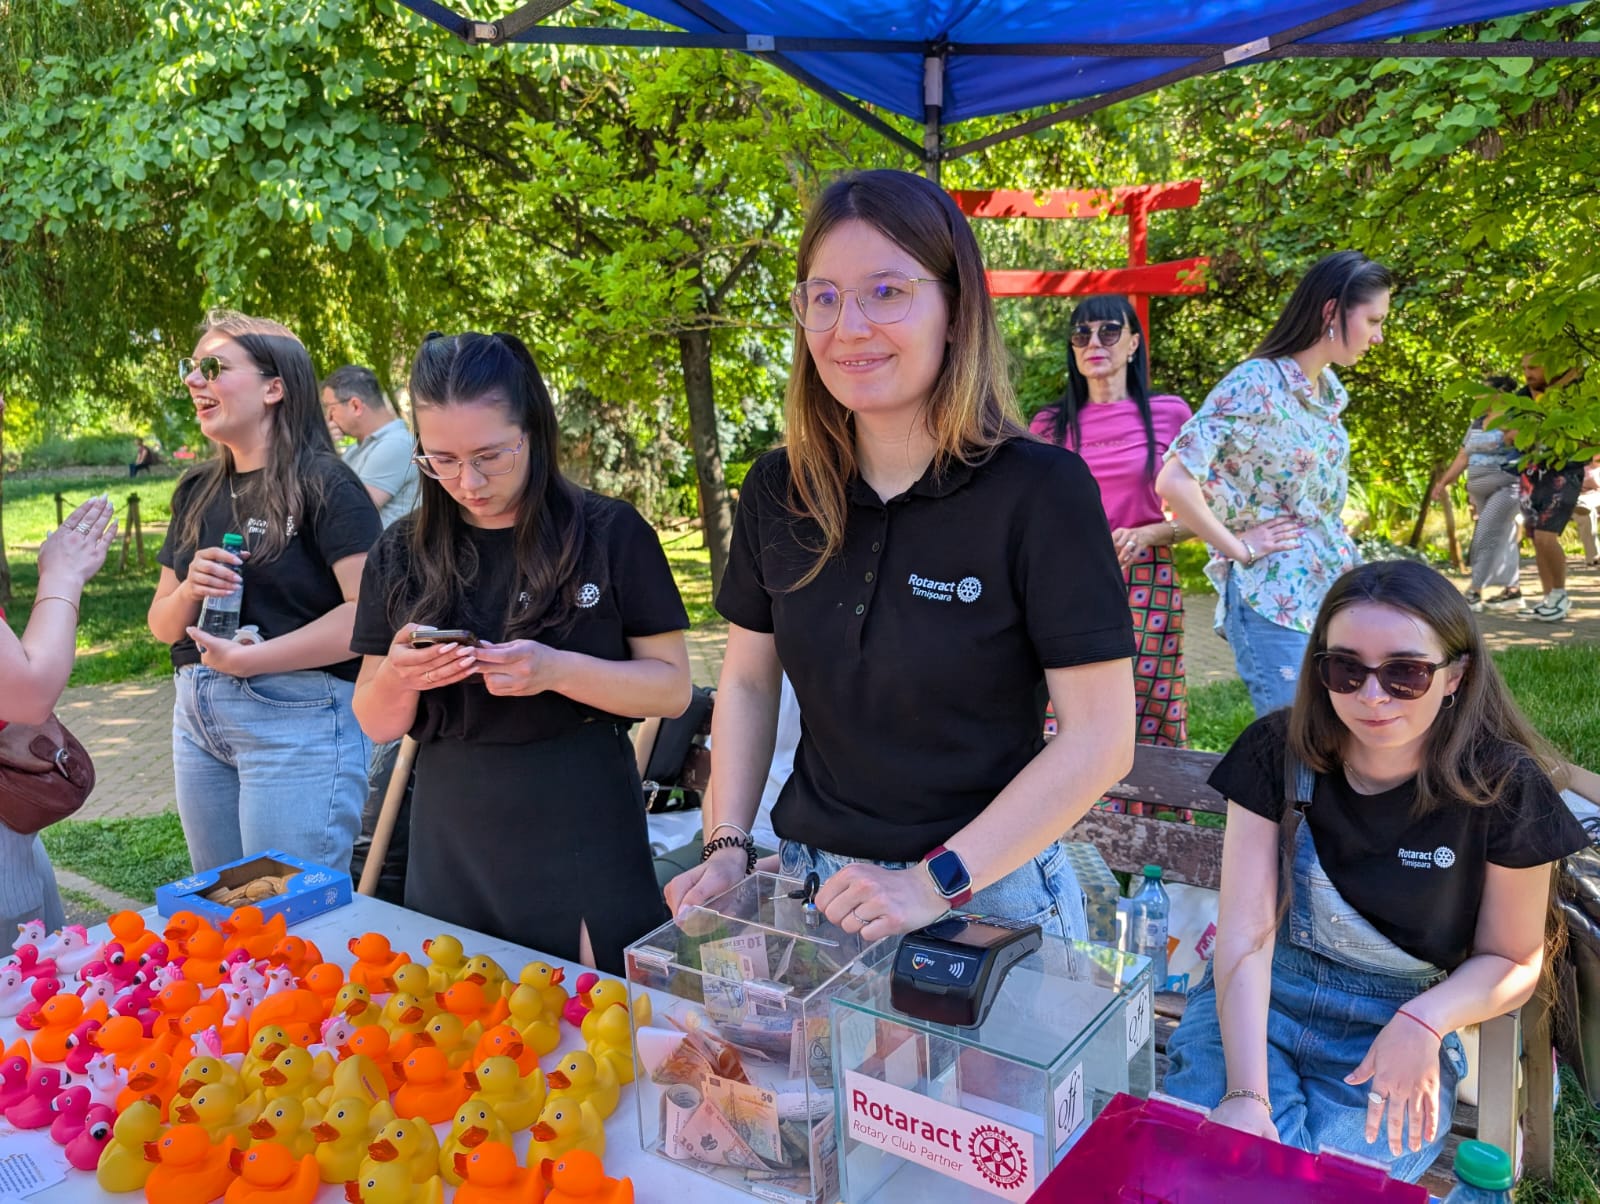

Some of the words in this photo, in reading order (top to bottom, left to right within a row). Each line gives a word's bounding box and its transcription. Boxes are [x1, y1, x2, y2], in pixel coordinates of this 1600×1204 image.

[908, 574, 956, 592] Rotaract
[1398, 848, 1432, 860] Rotaract
[1128, 991, 1147, 1047] off
[761, 1092, 773, 1104] 50
[852, 1089, 962, 1153] Rotaract
[1058, 1071, 1080, 1133] off
[853, 1119, 888, 1144] Rotary
[891, 1135, 917, 1154] Club
[920, 1146, 964, 1173] Partner
